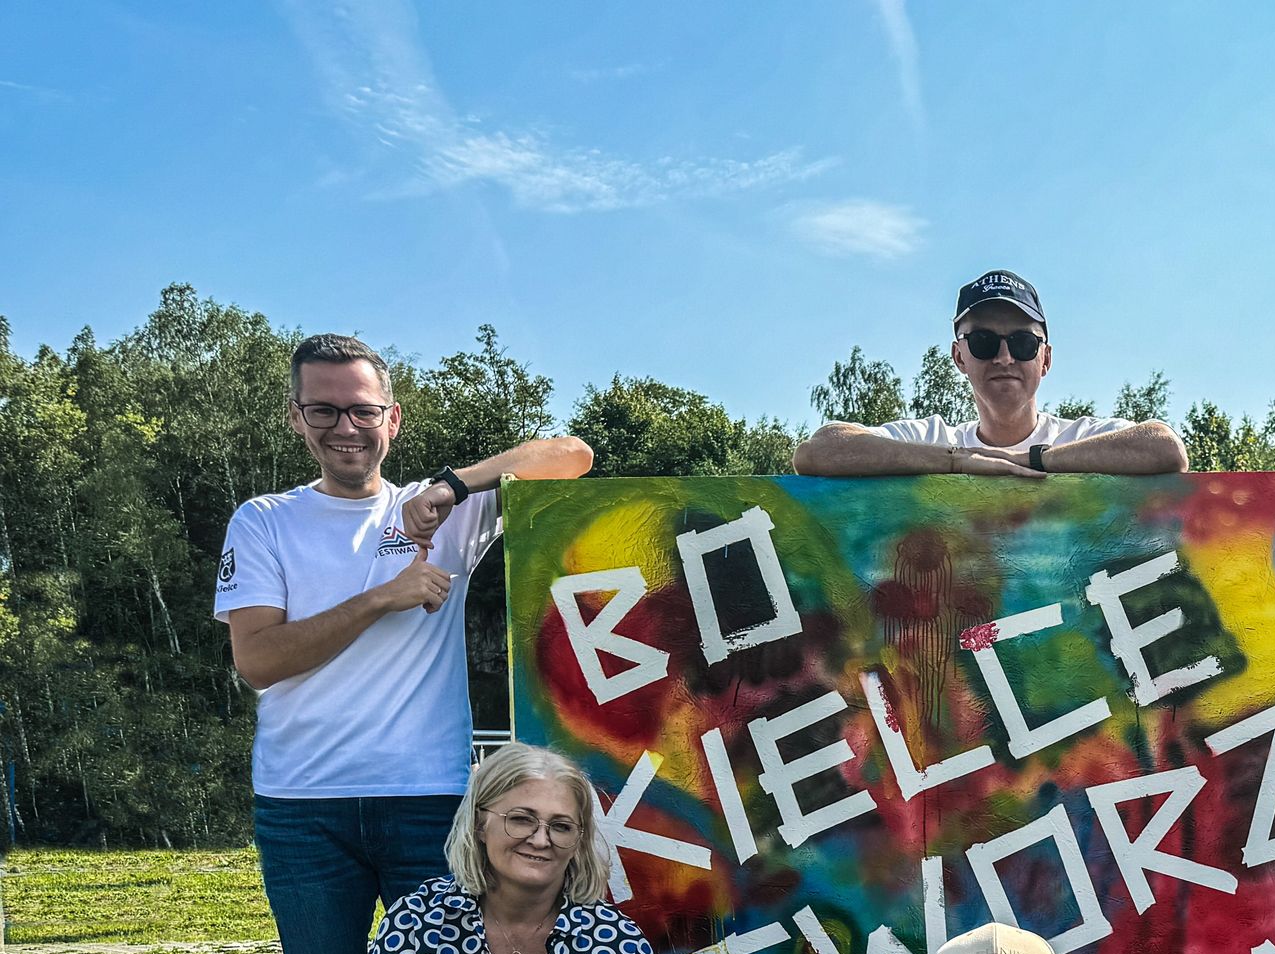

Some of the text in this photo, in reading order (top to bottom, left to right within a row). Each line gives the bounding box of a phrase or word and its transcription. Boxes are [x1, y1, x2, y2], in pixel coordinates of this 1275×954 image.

[971, 274, 1025, 290] ATHENS
[375, 545, 418, 558] ESTIWAL
[550, 506, 802, 705] BO
[591, 551, 1222, 904] KIELCE
